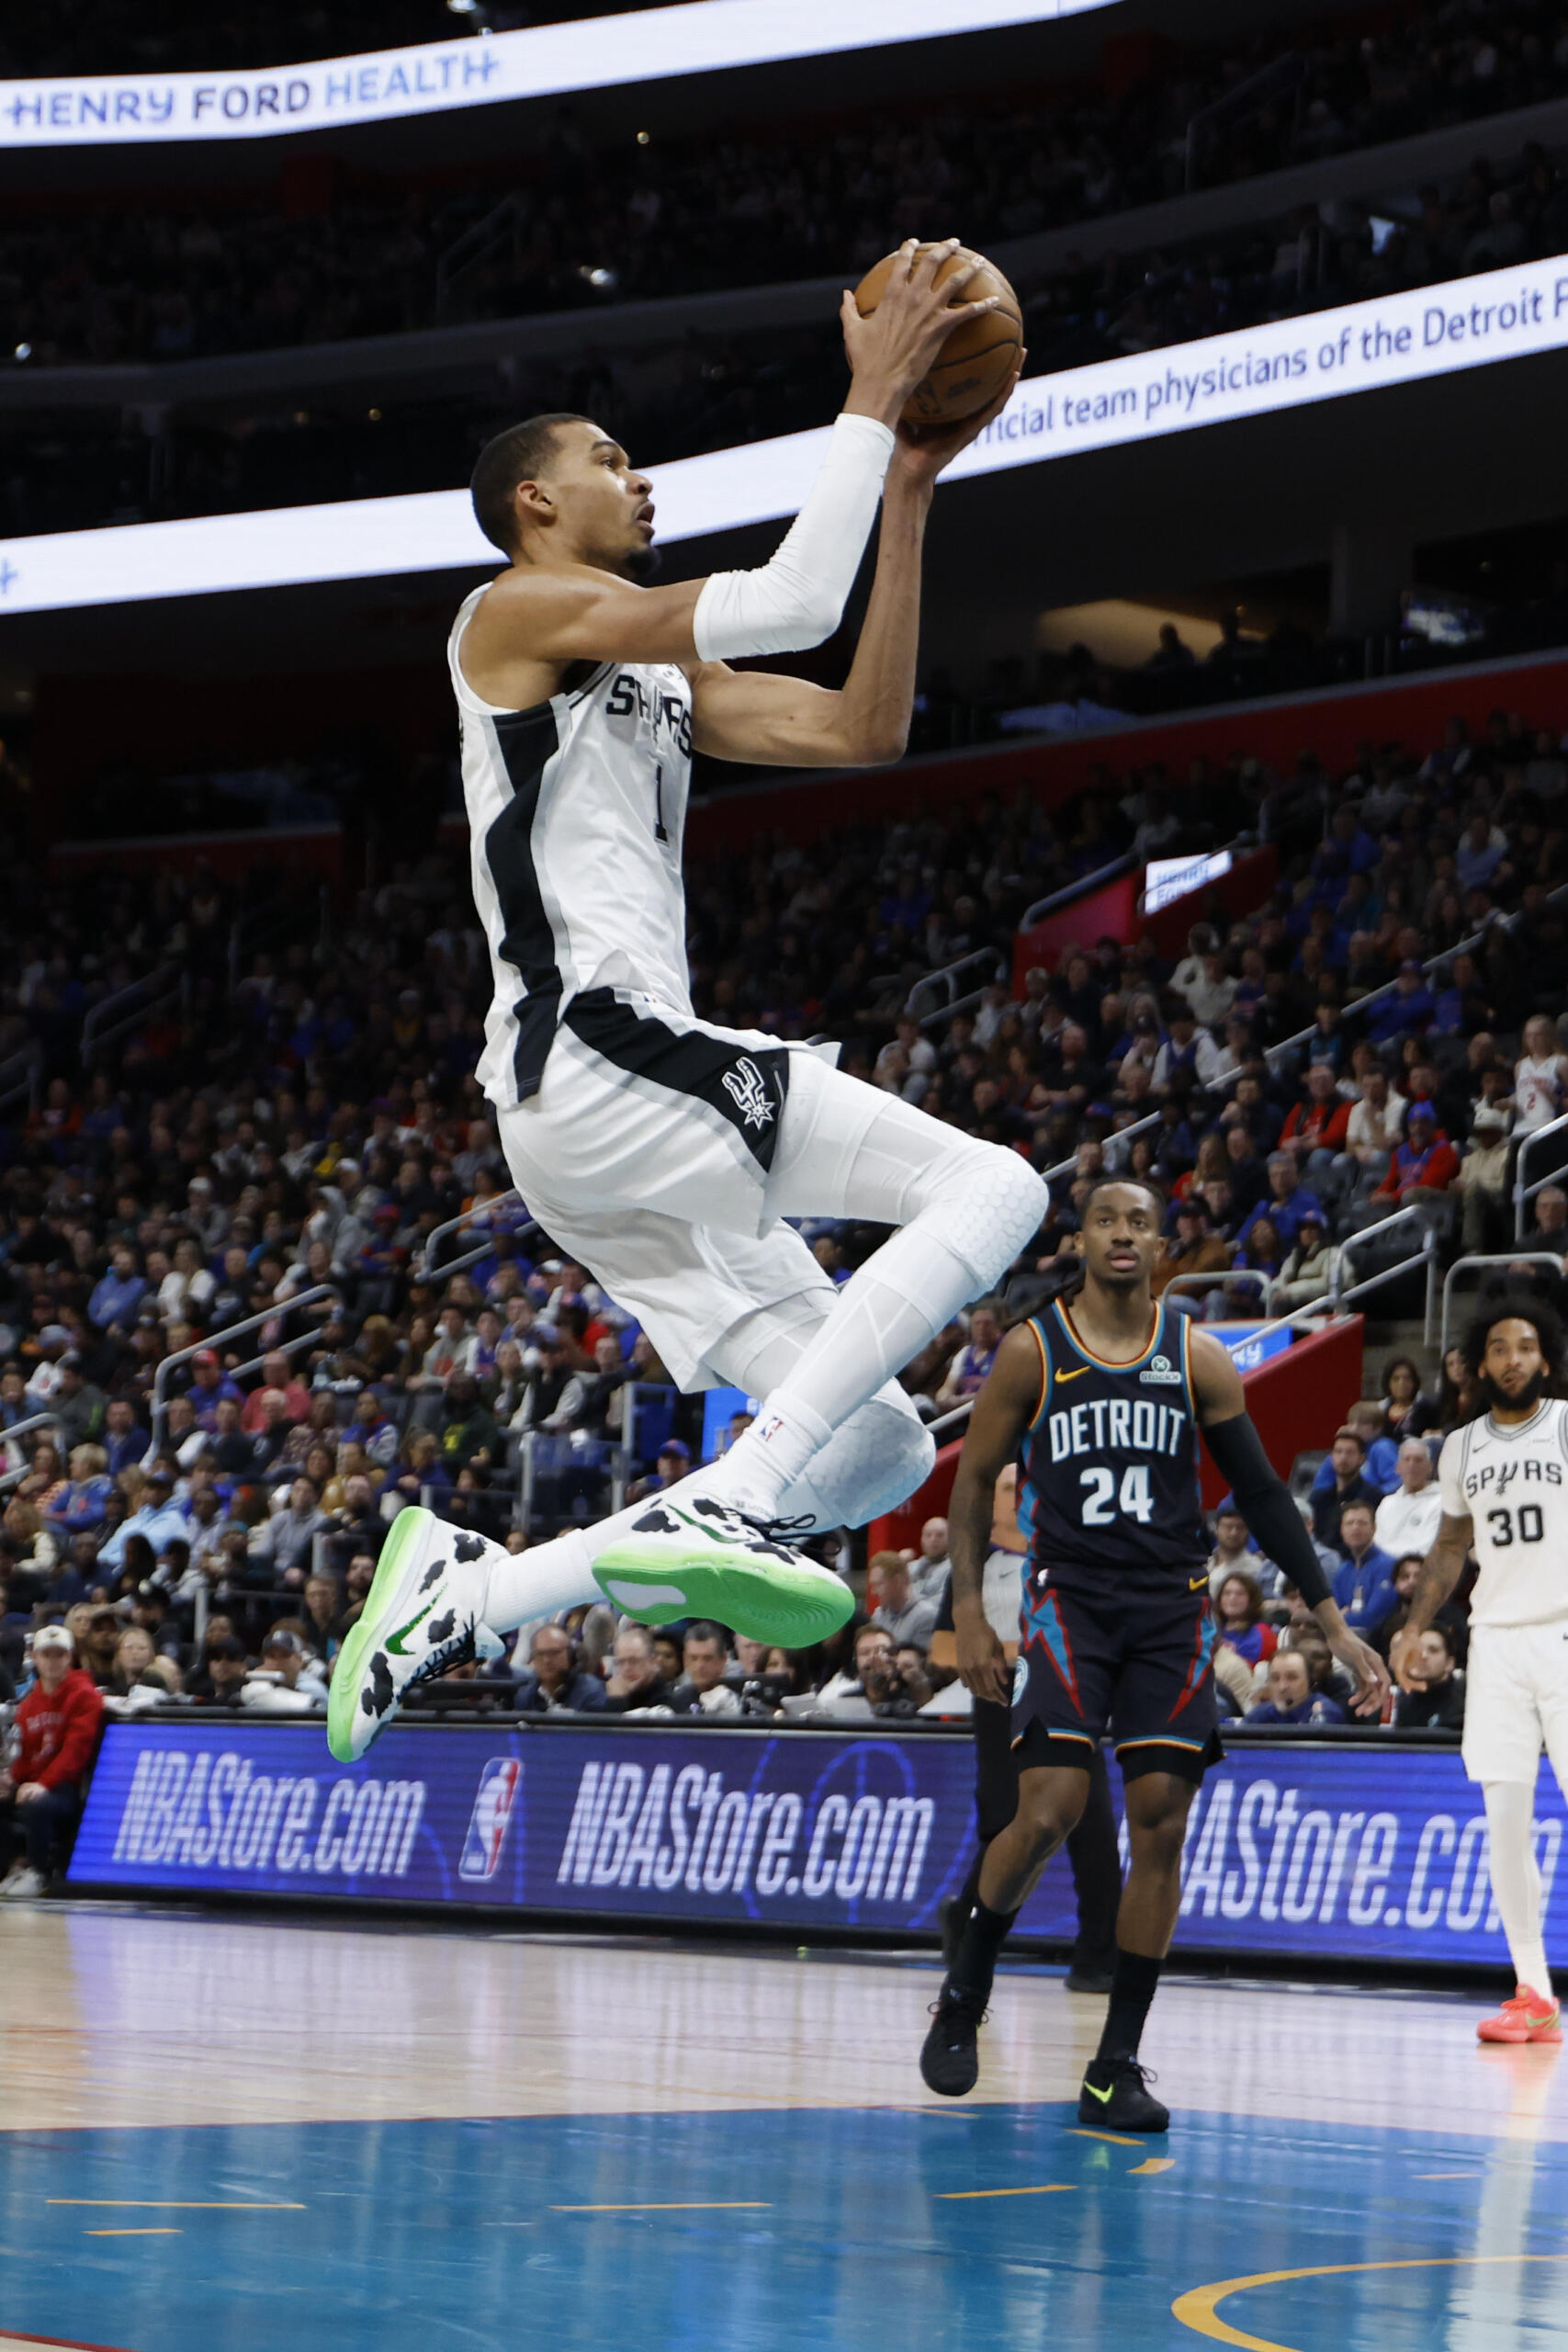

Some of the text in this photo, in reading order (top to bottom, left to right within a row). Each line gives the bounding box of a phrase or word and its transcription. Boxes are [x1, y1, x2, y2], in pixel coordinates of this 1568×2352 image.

[4, 49, 501, 127] HENRY FORD HEALTH
[1063, 377, 1137, 427] team
[1145, 349, 1308, 420] physicians
[1317, 326, 1352, 368] of
[1359, 320, 1413, 361] the
[1423, 287, 1544, 347] Detroit
[1049, 1398, 1186, 1464] DETROIT
[1079, 1464, 1155, 1526] 24
[1465, 1458, 1562, 1498] SPURS
[1486, 1503, 1544, 1547] 30
[112, 1750, 426, 1877] NBAStore.com
[555, 1760, 936, 1902] NBAStore.com
